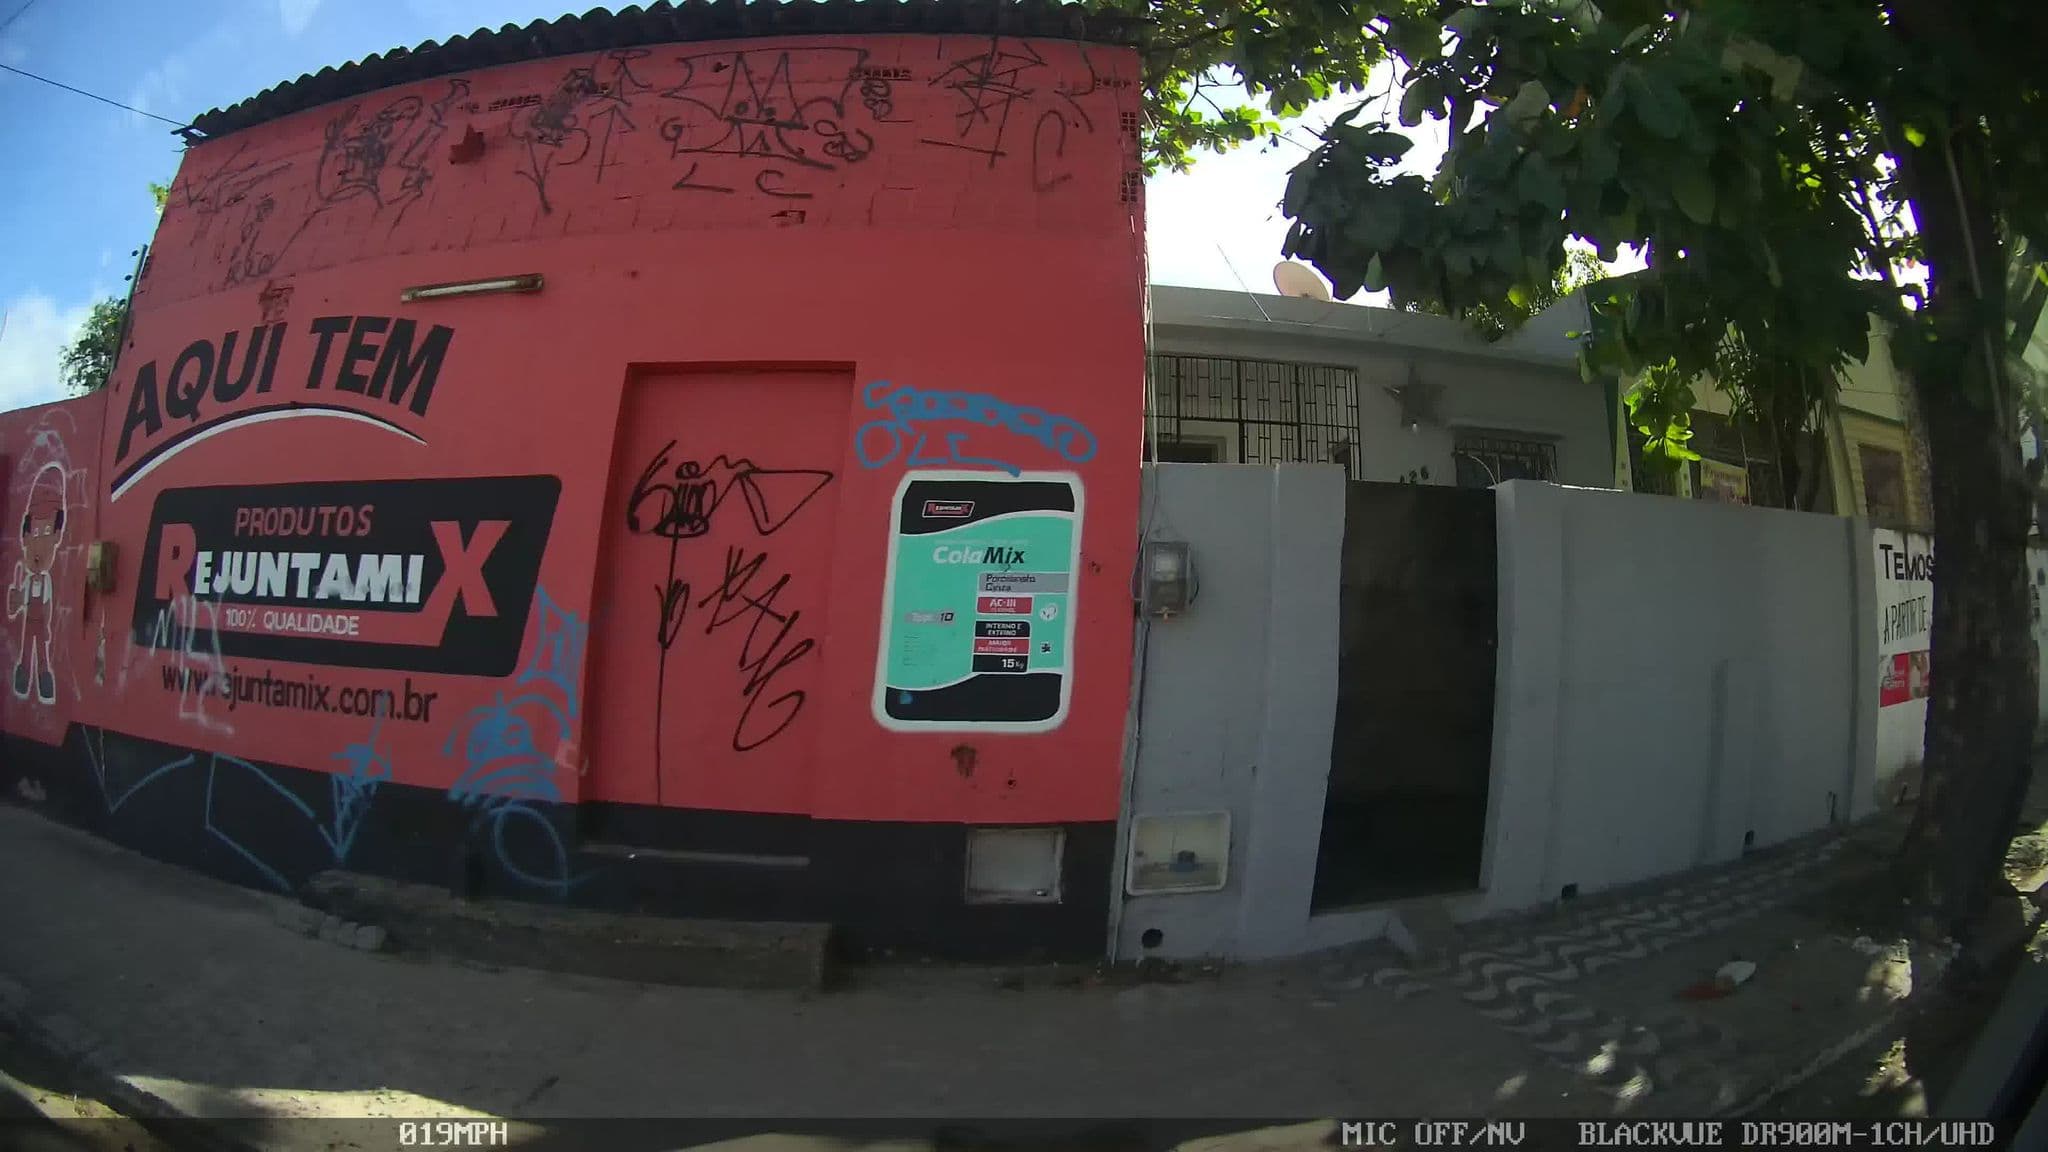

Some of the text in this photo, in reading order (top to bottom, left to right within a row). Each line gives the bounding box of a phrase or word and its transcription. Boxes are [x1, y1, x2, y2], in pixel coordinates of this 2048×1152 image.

[115, 316, 455, 465] AQUI TEM
[234, 504, 374, 537] PRODUTOS
[155, 519, 512, 618] REJUNTAMIX
[932, 546, 1025, 564] ColaMix
[225, 607, 360, 636] 100% QUALIDADE
[1002, 659, 1015, 669] 15
